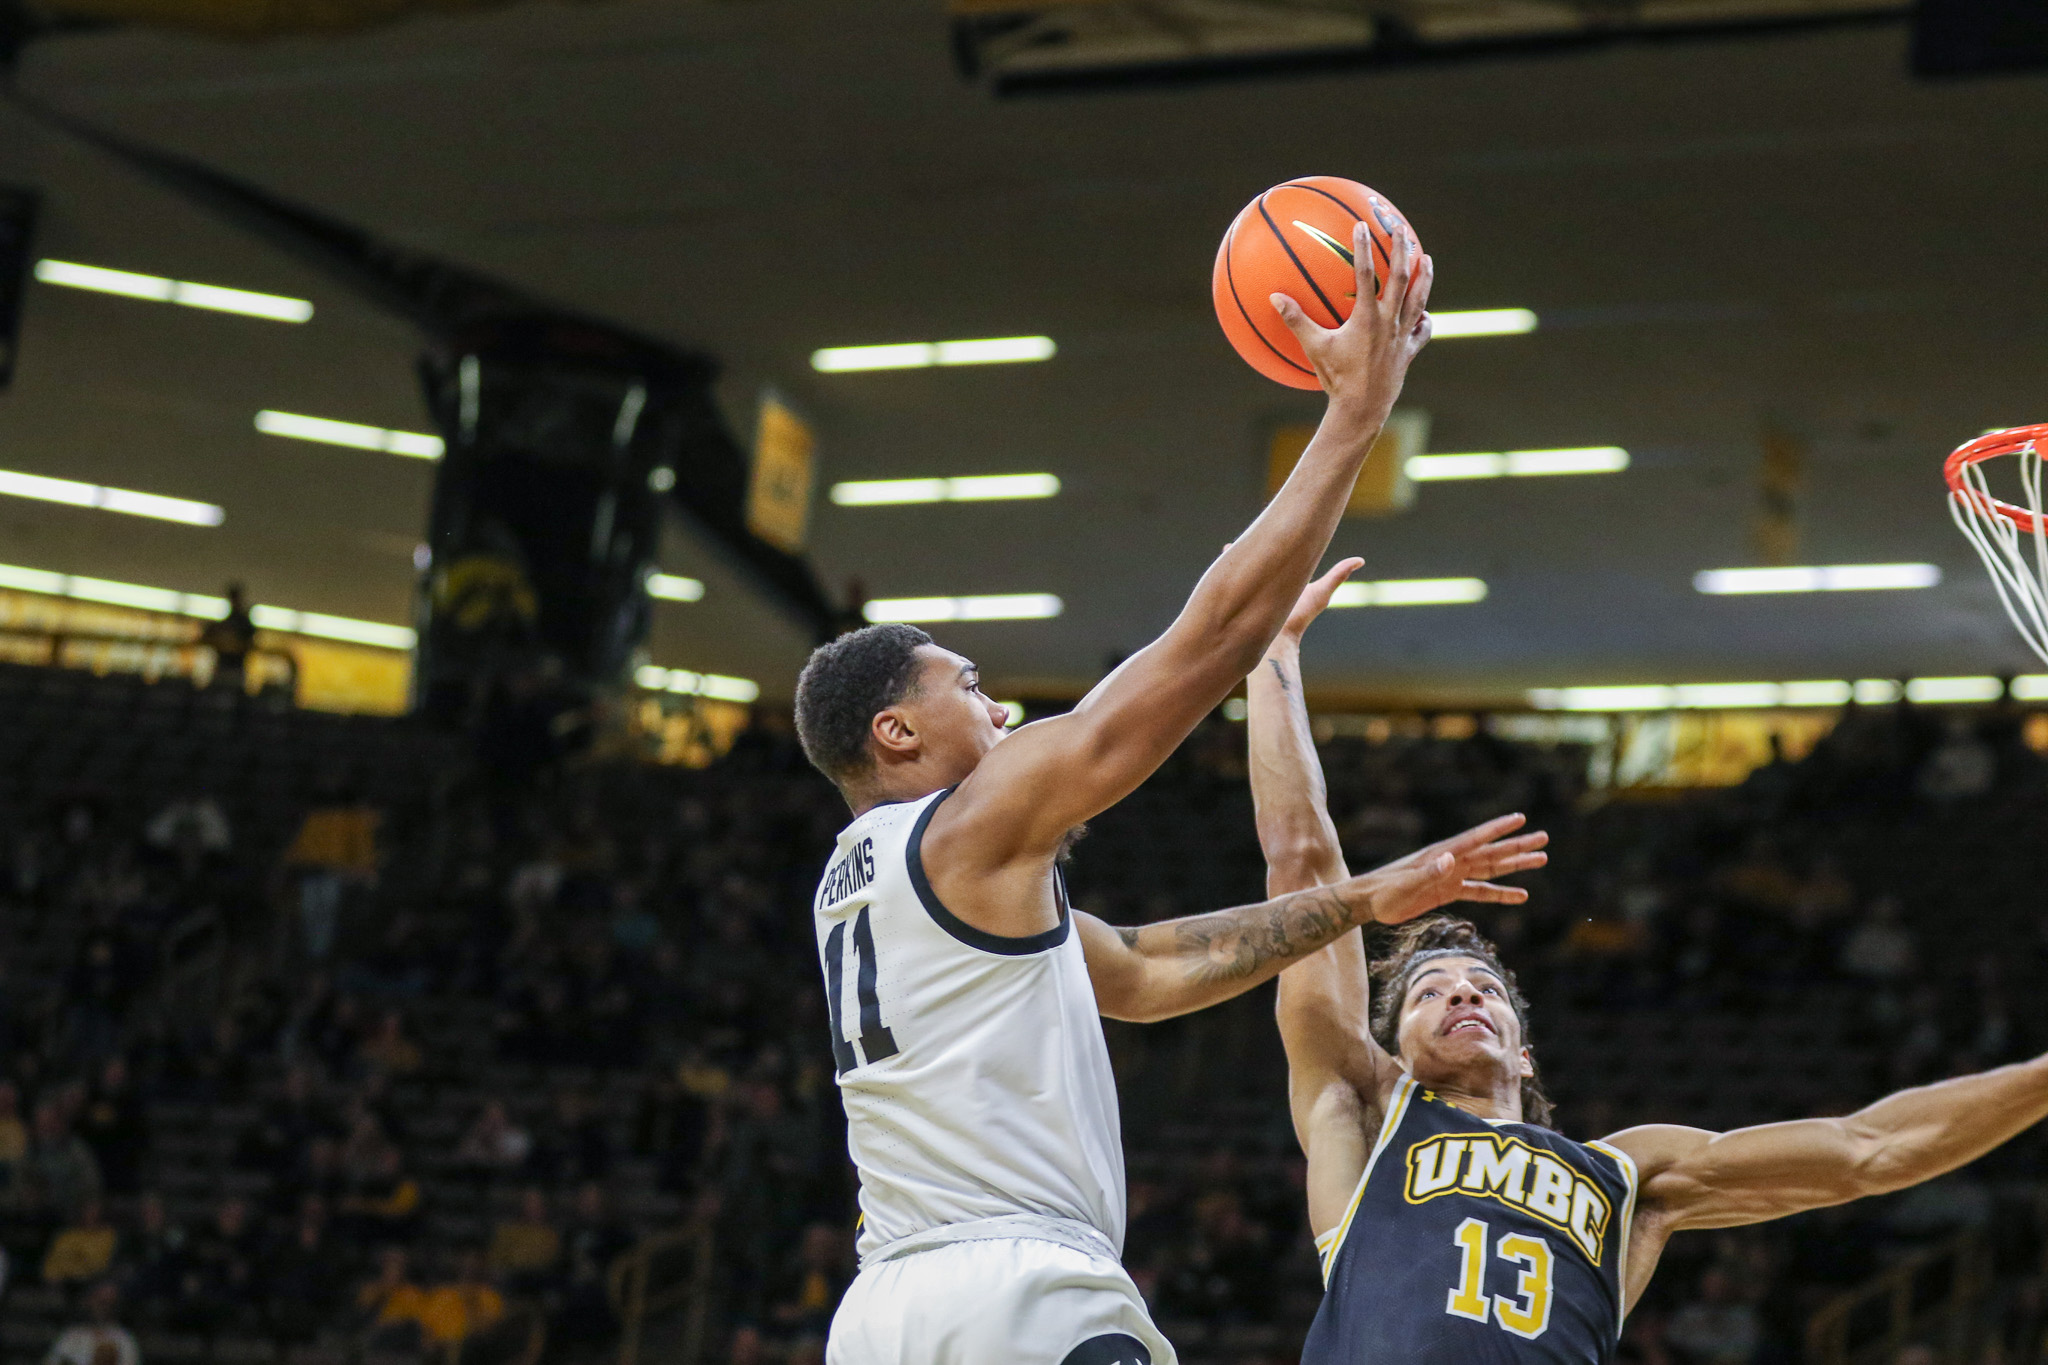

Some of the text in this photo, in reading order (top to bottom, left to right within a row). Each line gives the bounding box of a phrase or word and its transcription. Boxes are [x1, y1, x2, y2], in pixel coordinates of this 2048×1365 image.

[819, 836, 875, 910] PERKINS
[824, 903, 900, 1080] 11
[1405, 1133, 1610, 1265] UMBC
[1446, 1217, 1554, 1340] 13
